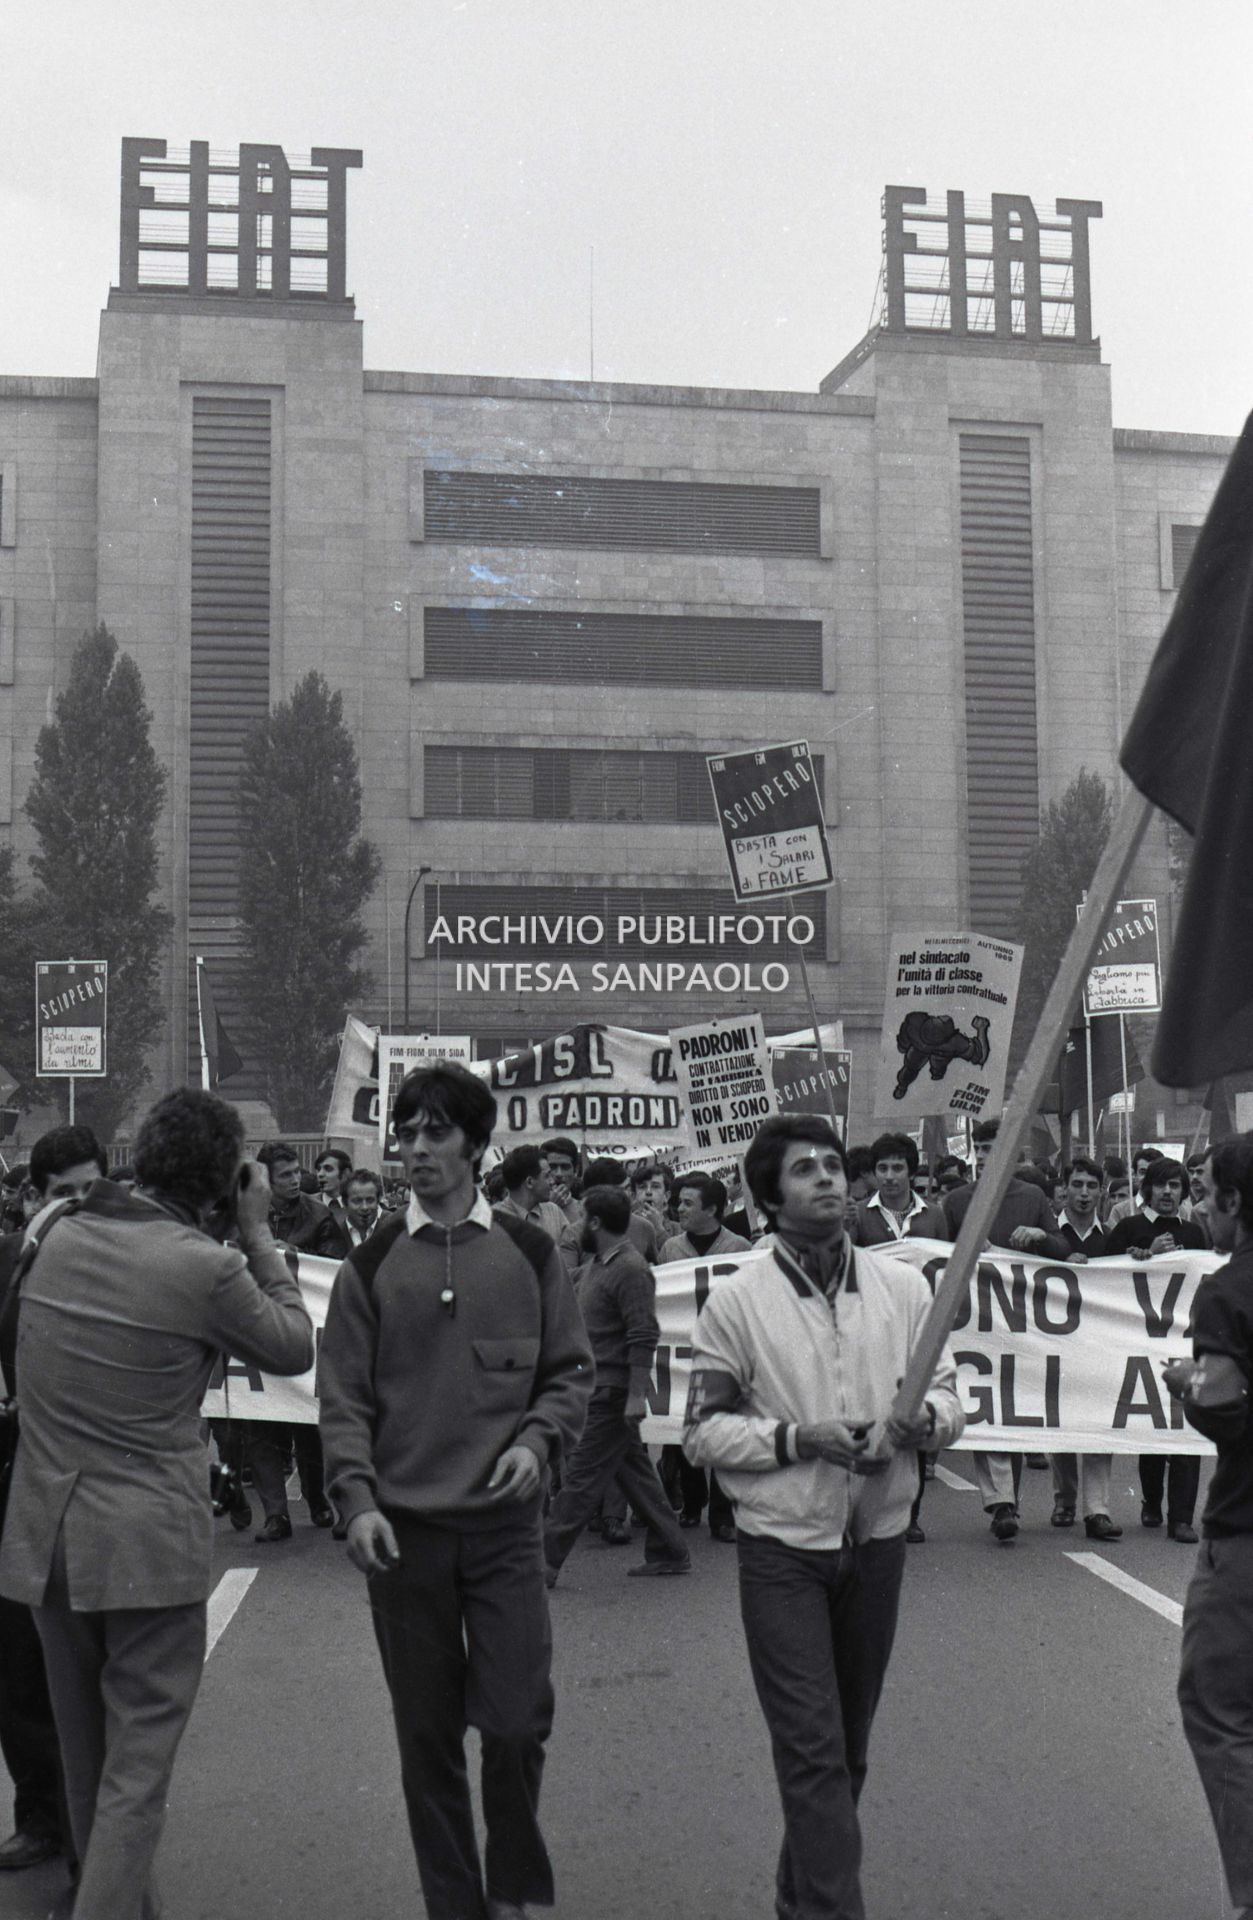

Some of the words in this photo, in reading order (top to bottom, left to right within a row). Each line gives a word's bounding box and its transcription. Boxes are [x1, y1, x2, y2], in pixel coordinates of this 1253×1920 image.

[120, 137, 362, 298] FIAT
[885, 185, 1102, 343] FIAT
[724, 762, 810, 829] SCIOPERO
[758, 866, 808, 889] FAME
[977, 940, 1014, 955] AUTUNNO
[1097, 915, 1154, 955] IOPERO
[899, 951, 916, 965] nel
[919, 950, 970, 965] sindacato
[897, 967, 932, 982] l'unità
[934, 968, 945, 981] di
[948, 967, 983, 982] classe
[40, 977, 104, 1020] SCIOPERO
[896, 986, 910, 997] per
[913, 984, 922, 996] la
[924, 984, 955, 995] vittoria
[957, 984, 1008, 1005] contrattuale
[497, 1032, 612, 1086] CISL
[689, 1053, 756, 1078] CONTRATTAZIONE
[689, 1087, 719, 1105] DIRITTO
[720, 1085, 729, 1099] DI
[730, 1078, 766, 1097] SCIOPERO
[953, 1089, 986, 1105] FIOM
[966, 1082, 990, 1097] FIM
[547, 1097, 677, 1126] PADRONI
[692, 1104, 723, 1126] NON
[730, 1096, 770, 1120] SONO
[949, 1099, 982, 1115] UILM
[696, 1129, 711, 1148] IN
